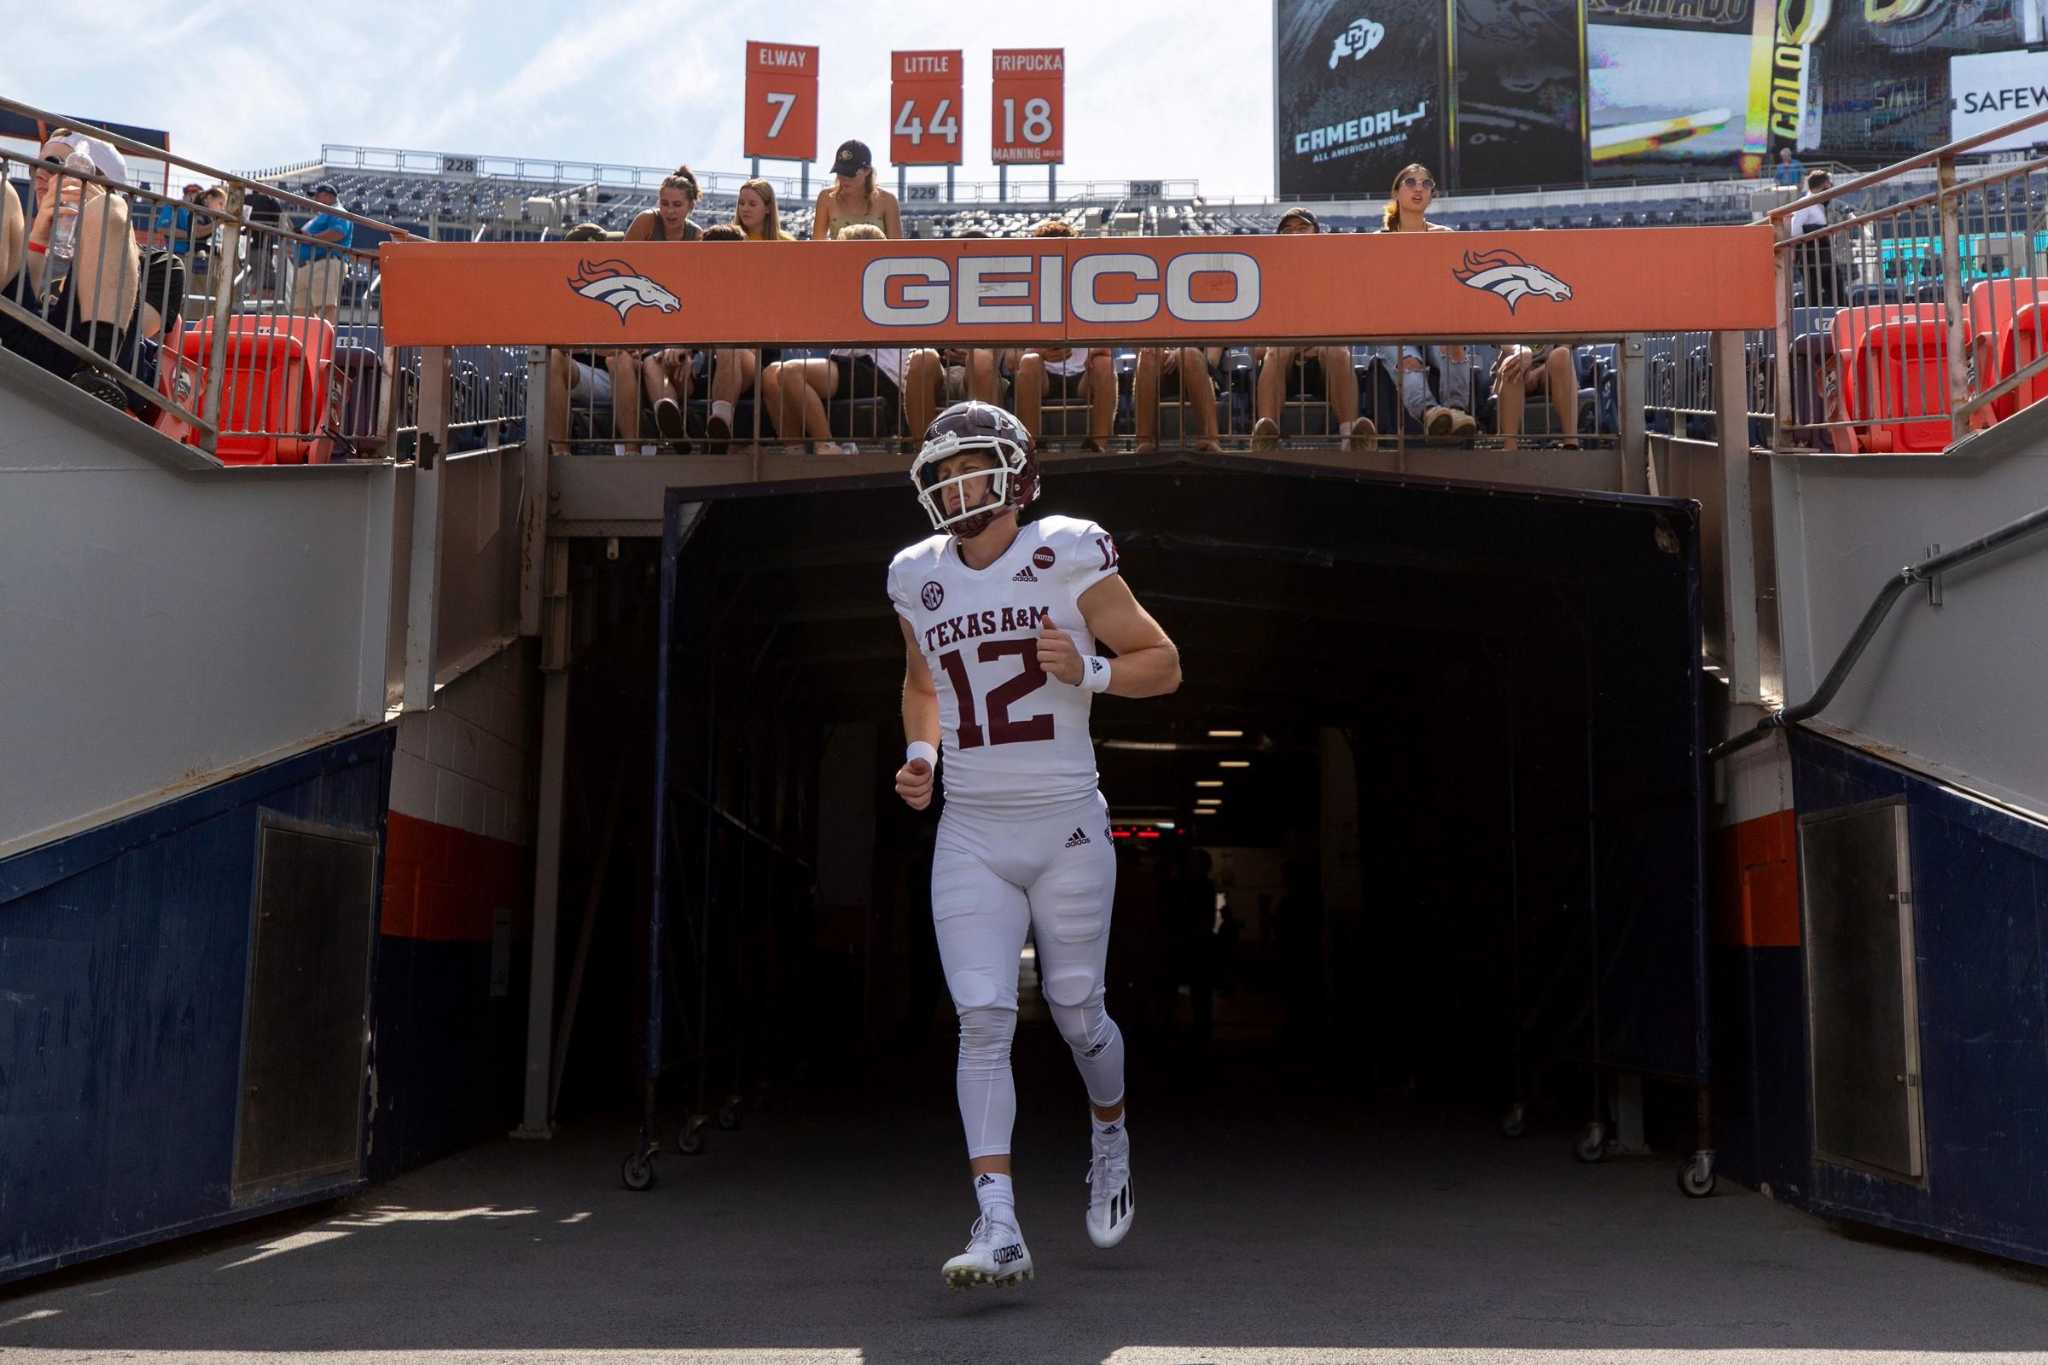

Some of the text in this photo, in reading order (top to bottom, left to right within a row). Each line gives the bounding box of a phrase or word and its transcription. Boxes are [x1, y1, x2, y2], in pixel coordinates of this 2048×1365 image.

[759, 48, 806, 68] ELWAY
[904, 56, 950, 73] LITTLE
[993, 54, 1063, 71] TRIPUCKA
[767, 93, 798, 139] 7
[894, 98, 959, 145] 44
[1002, 97, 1053, 144] 18
[992, 147, 1041, 160] MANNING
[1313, 132, 1408, 163] ALL AMERICAN VODKA
[446, 159, 474, 172] 228
[911, 187, 937, 199] 229
[1133, 184, 1160, 197] 230
[862, 252, 1261, 327] GEICO
[925, 606, 1049, 651] TEXAS A&M
[939, 638, 1055, 749] 12
